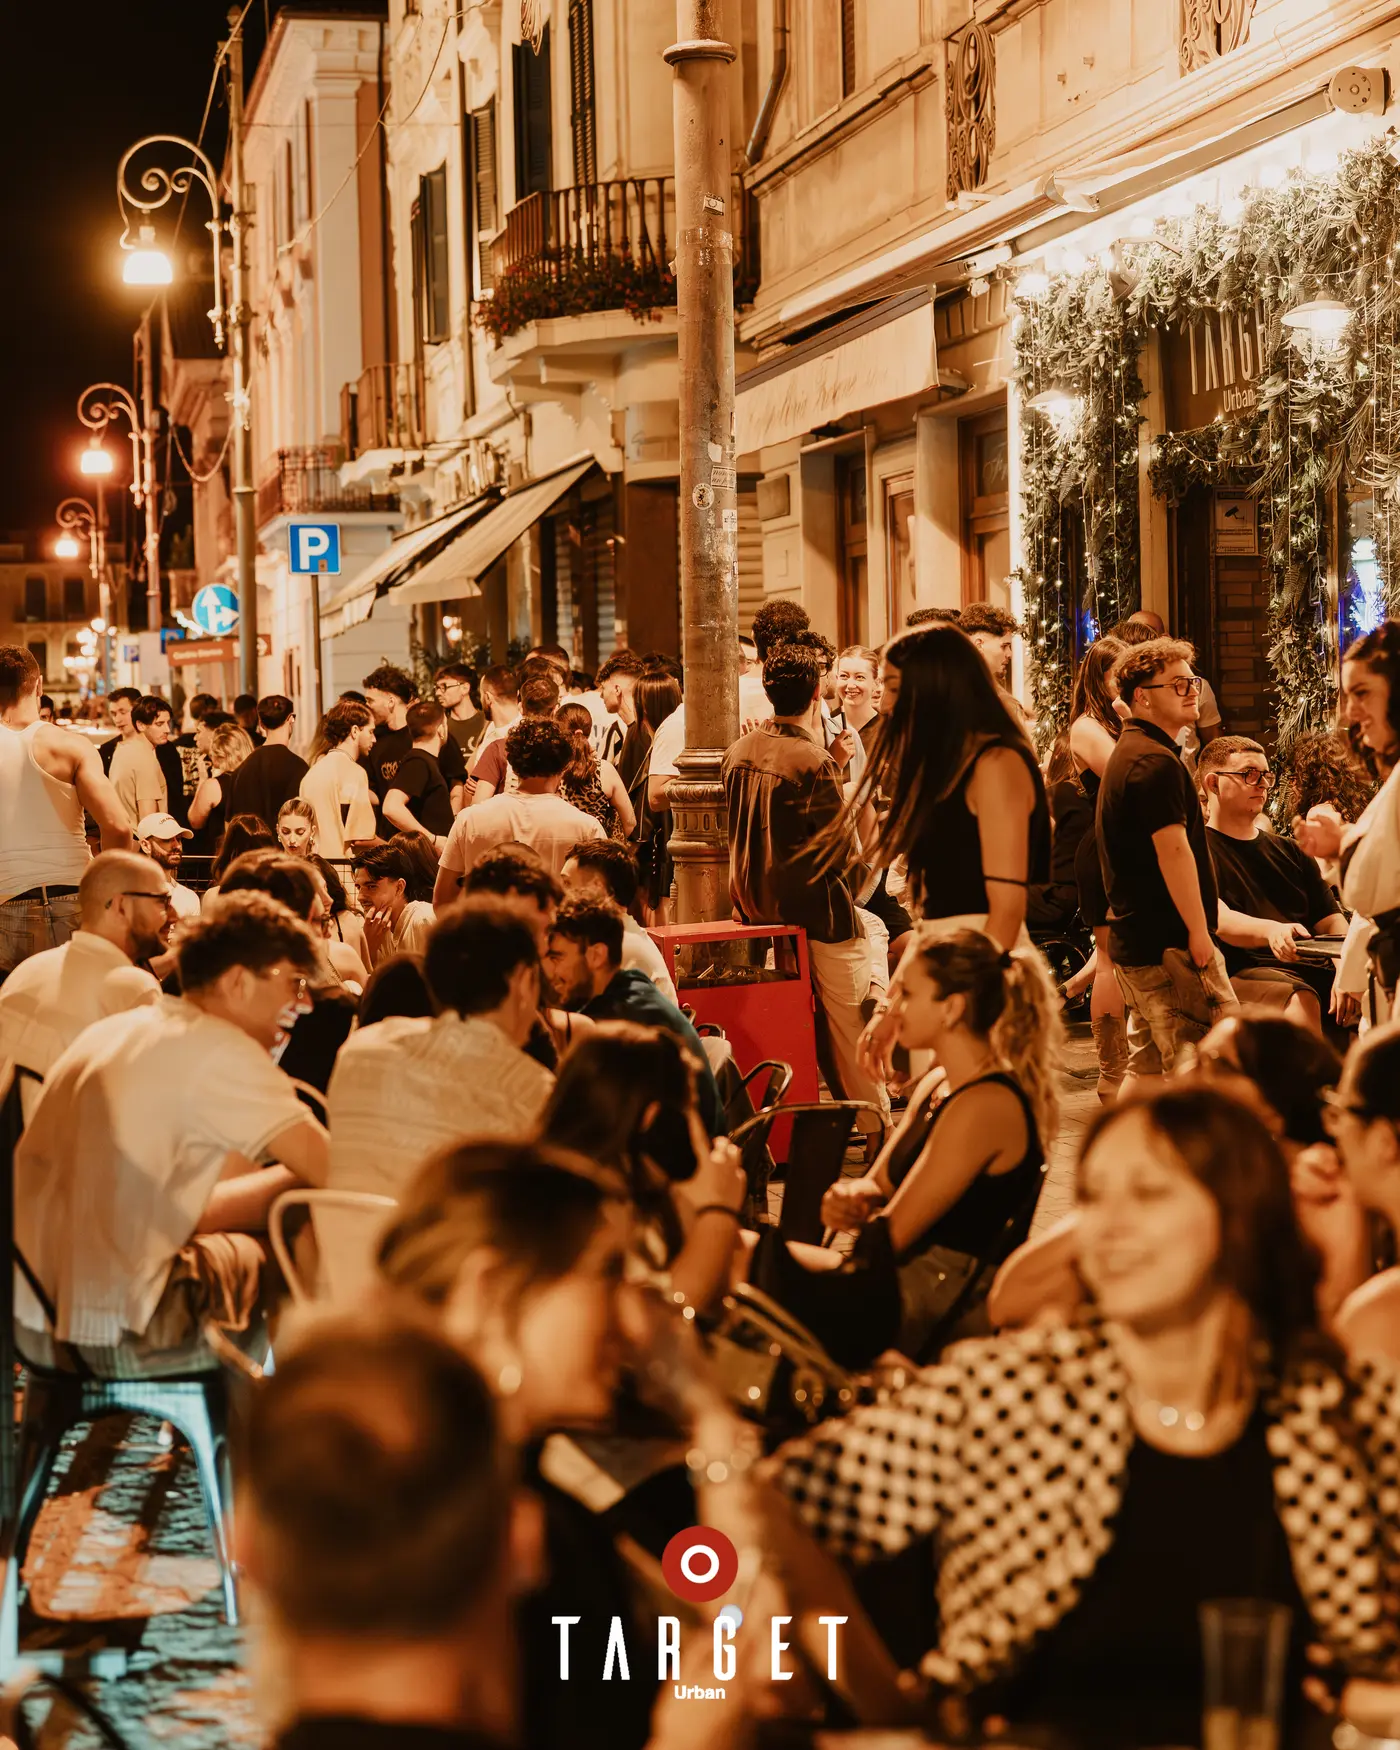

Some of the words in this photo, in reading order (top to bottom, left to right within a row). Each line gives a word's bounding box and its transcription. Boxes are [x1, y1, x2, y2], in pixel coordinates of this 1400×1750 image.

[1187, 297, 1268, 396] TARGE
[1223, 387, 1256, 413] Urban
[299, 527, 329, 570] P
